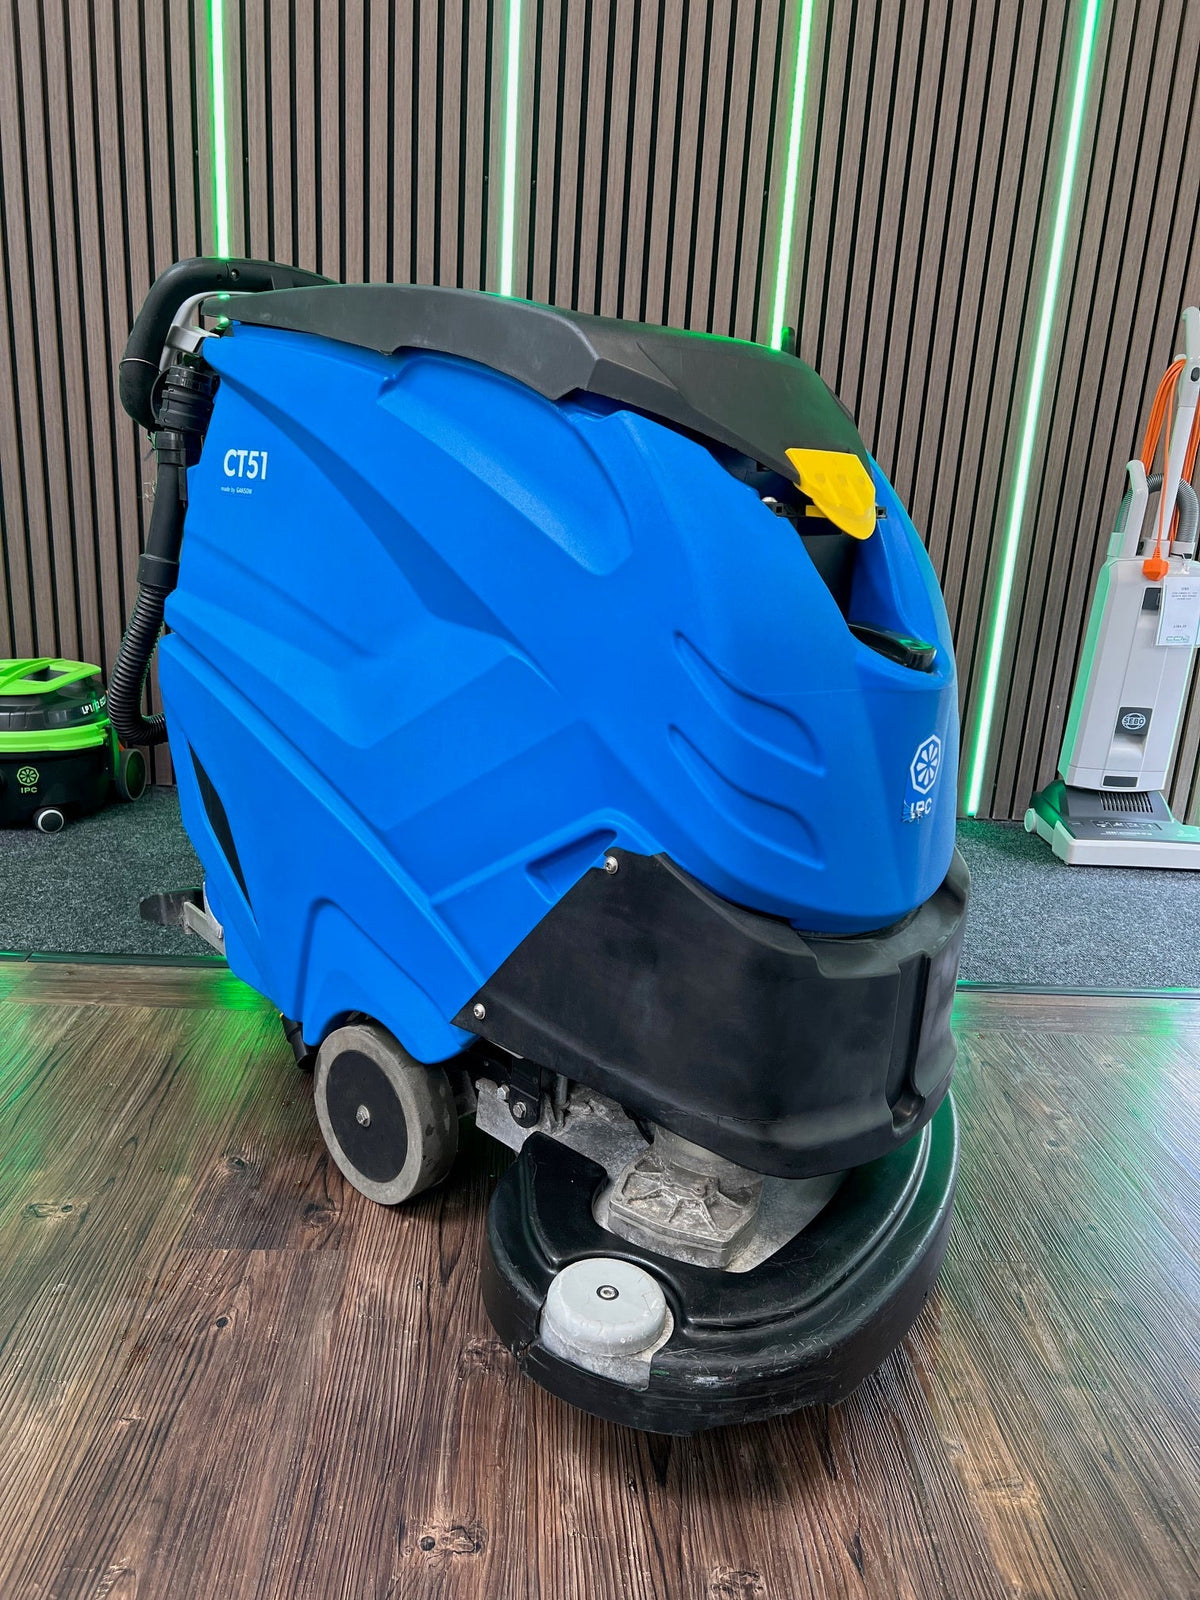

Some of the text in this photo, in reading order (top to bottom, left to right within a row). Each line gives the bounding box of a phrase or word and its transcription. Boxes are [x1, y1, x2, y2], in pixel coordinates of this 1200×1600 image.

[223, 448, 268, 480] CT51
[1123, 717, 1145, 725] SEBO
[20, 786, 38, 794] IPC
[910, 797, 933, 820] IPC
